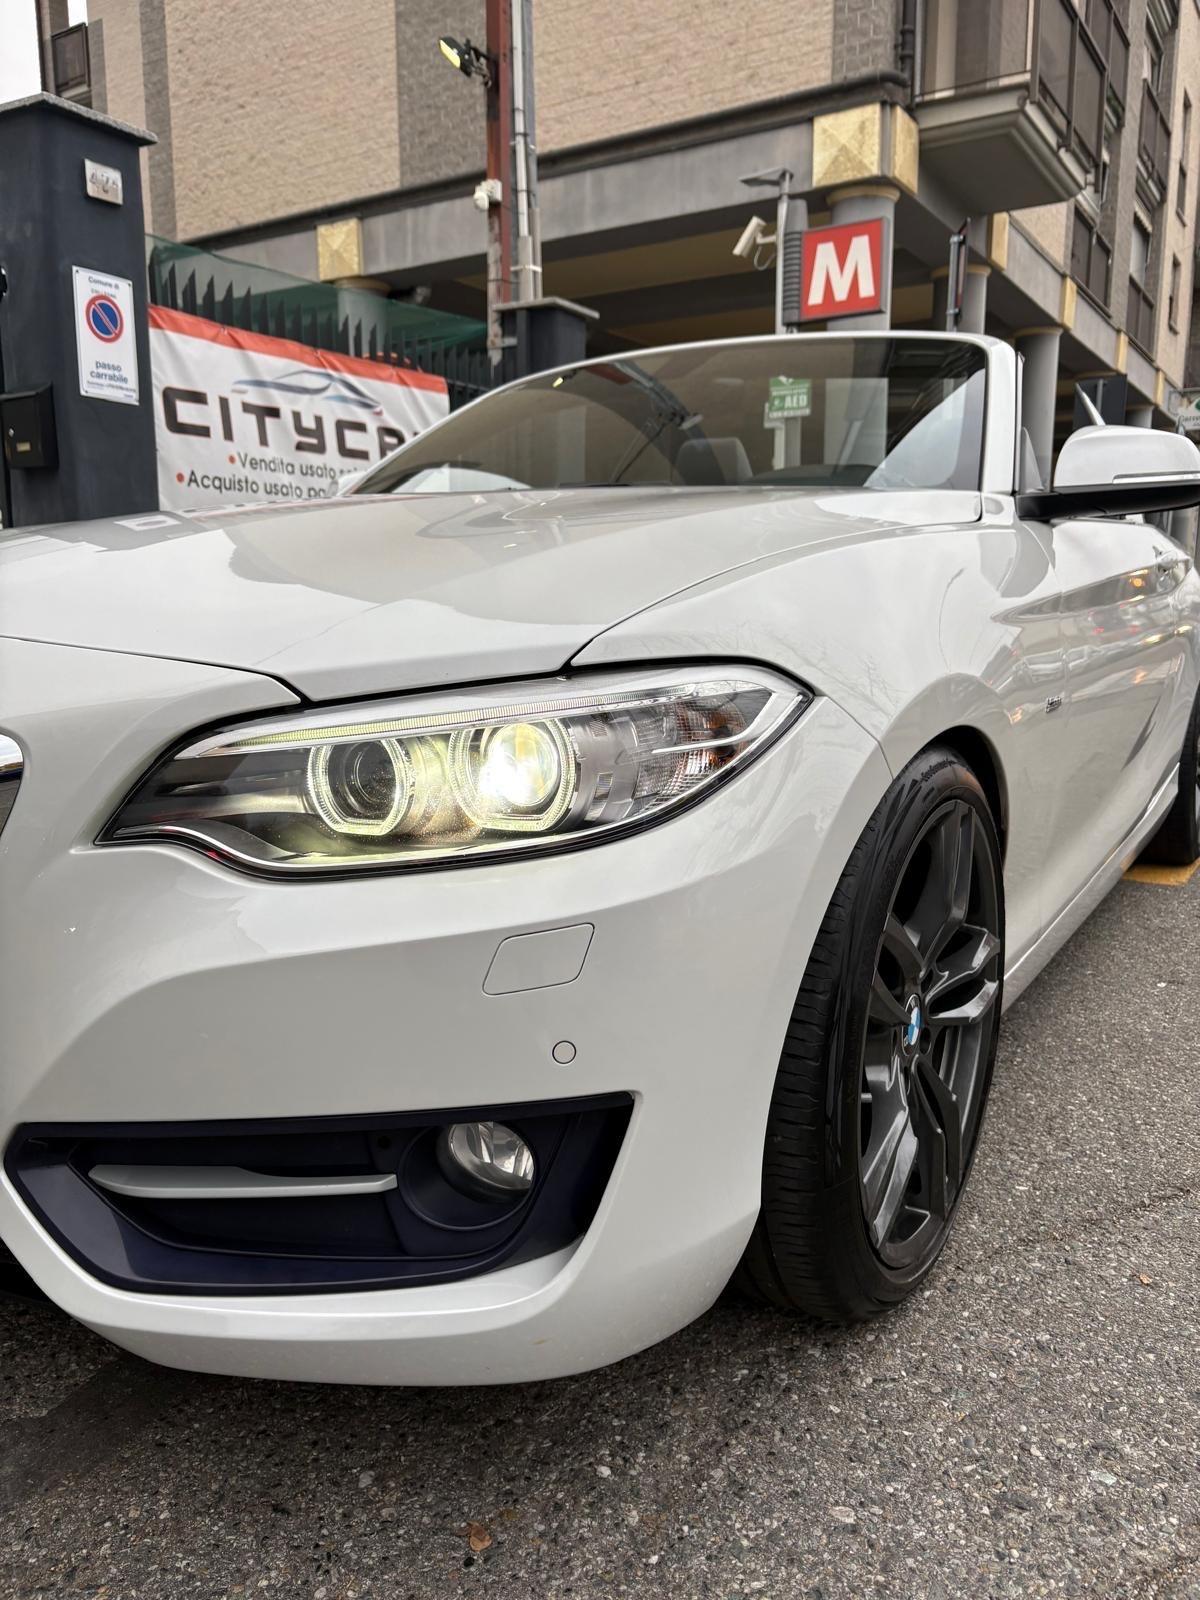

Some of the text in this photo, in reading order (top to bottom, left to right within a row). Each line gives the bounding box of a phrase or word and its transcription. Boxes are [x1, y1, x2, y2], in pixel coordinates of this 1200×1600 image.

[807, 234, 875, 306] M
[90, 370, 129, 384] carrabile
[95, 361, 122, 372] passo
[784, 394, 808, 409] AED
[162, 386, 419, 461] CITYCA
[238, 452, 295, 475] Vendita
[300, 463, 336, 480] usato
[187, 470, 259, 494] Acquisto
[264, 481, 303, 498] usato
